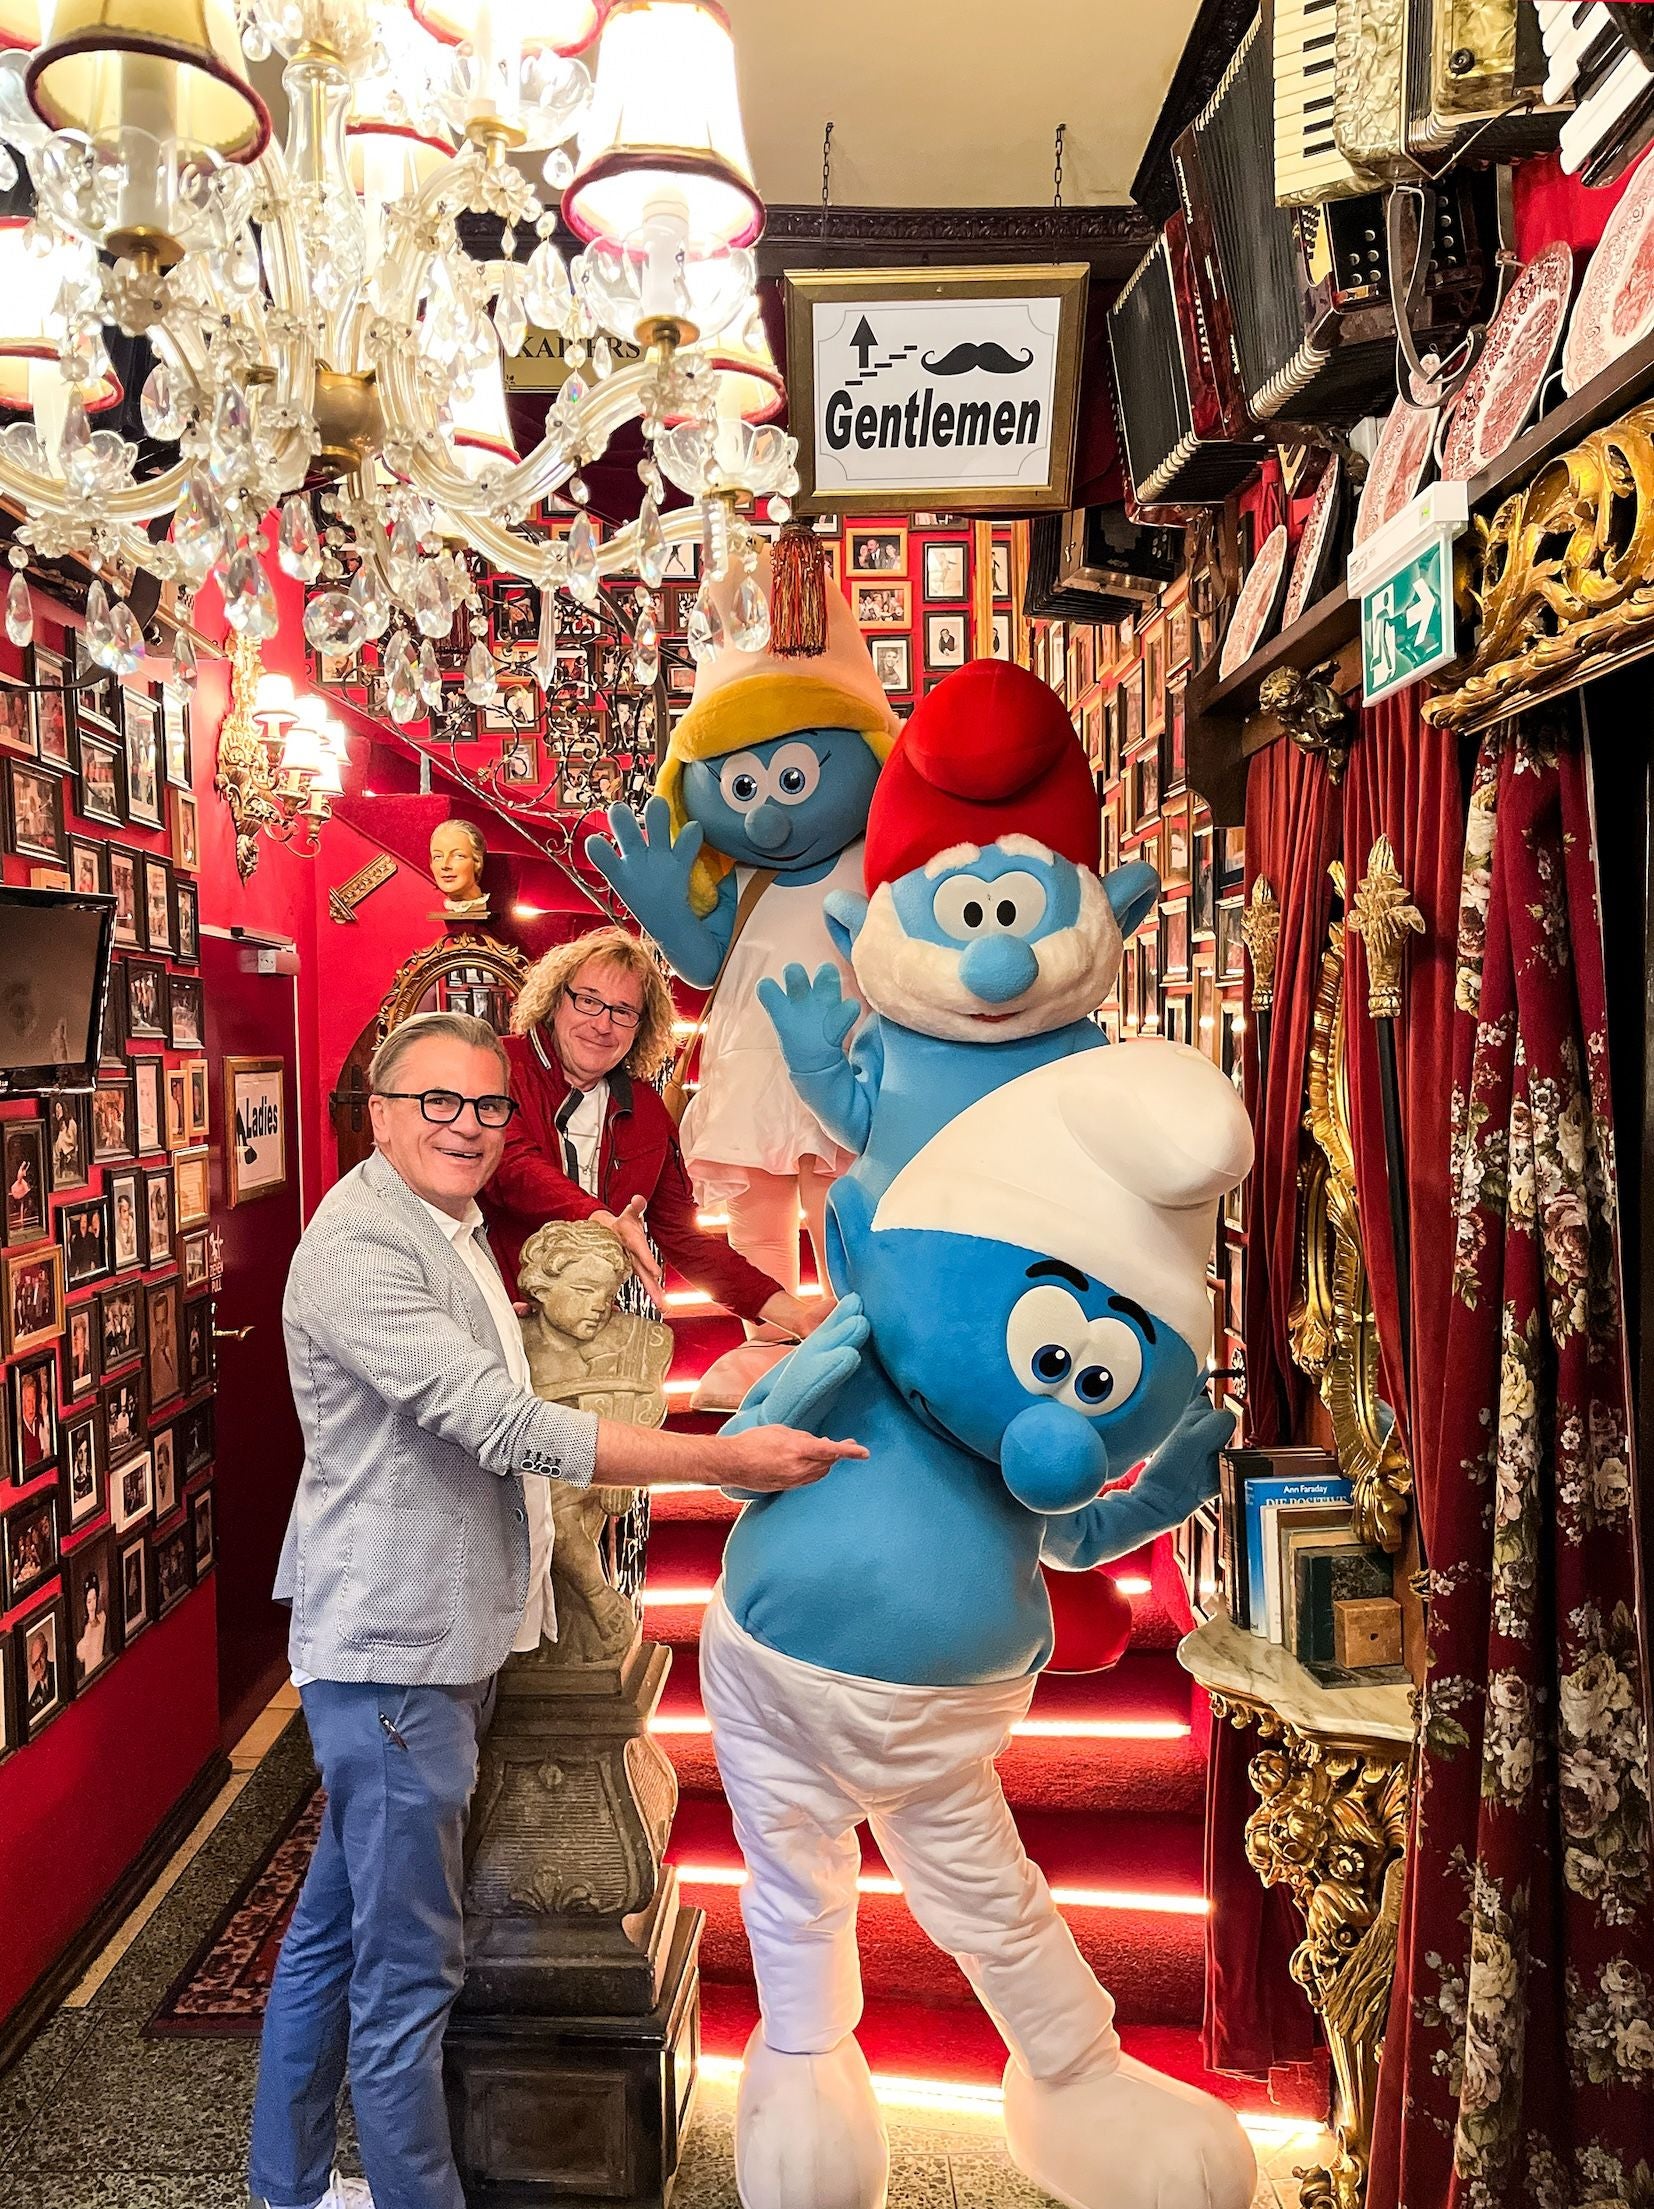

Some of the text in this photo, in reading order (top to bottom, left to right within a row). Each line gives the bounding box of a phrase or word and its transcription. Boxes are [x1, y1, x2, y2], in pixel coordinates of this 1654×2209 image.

[825, 387, 1041, 451] Gentlemen
[245, 1095, 278, 1139] Ladies
[1283, 1485, 1328, 1495] Ann Faraday
